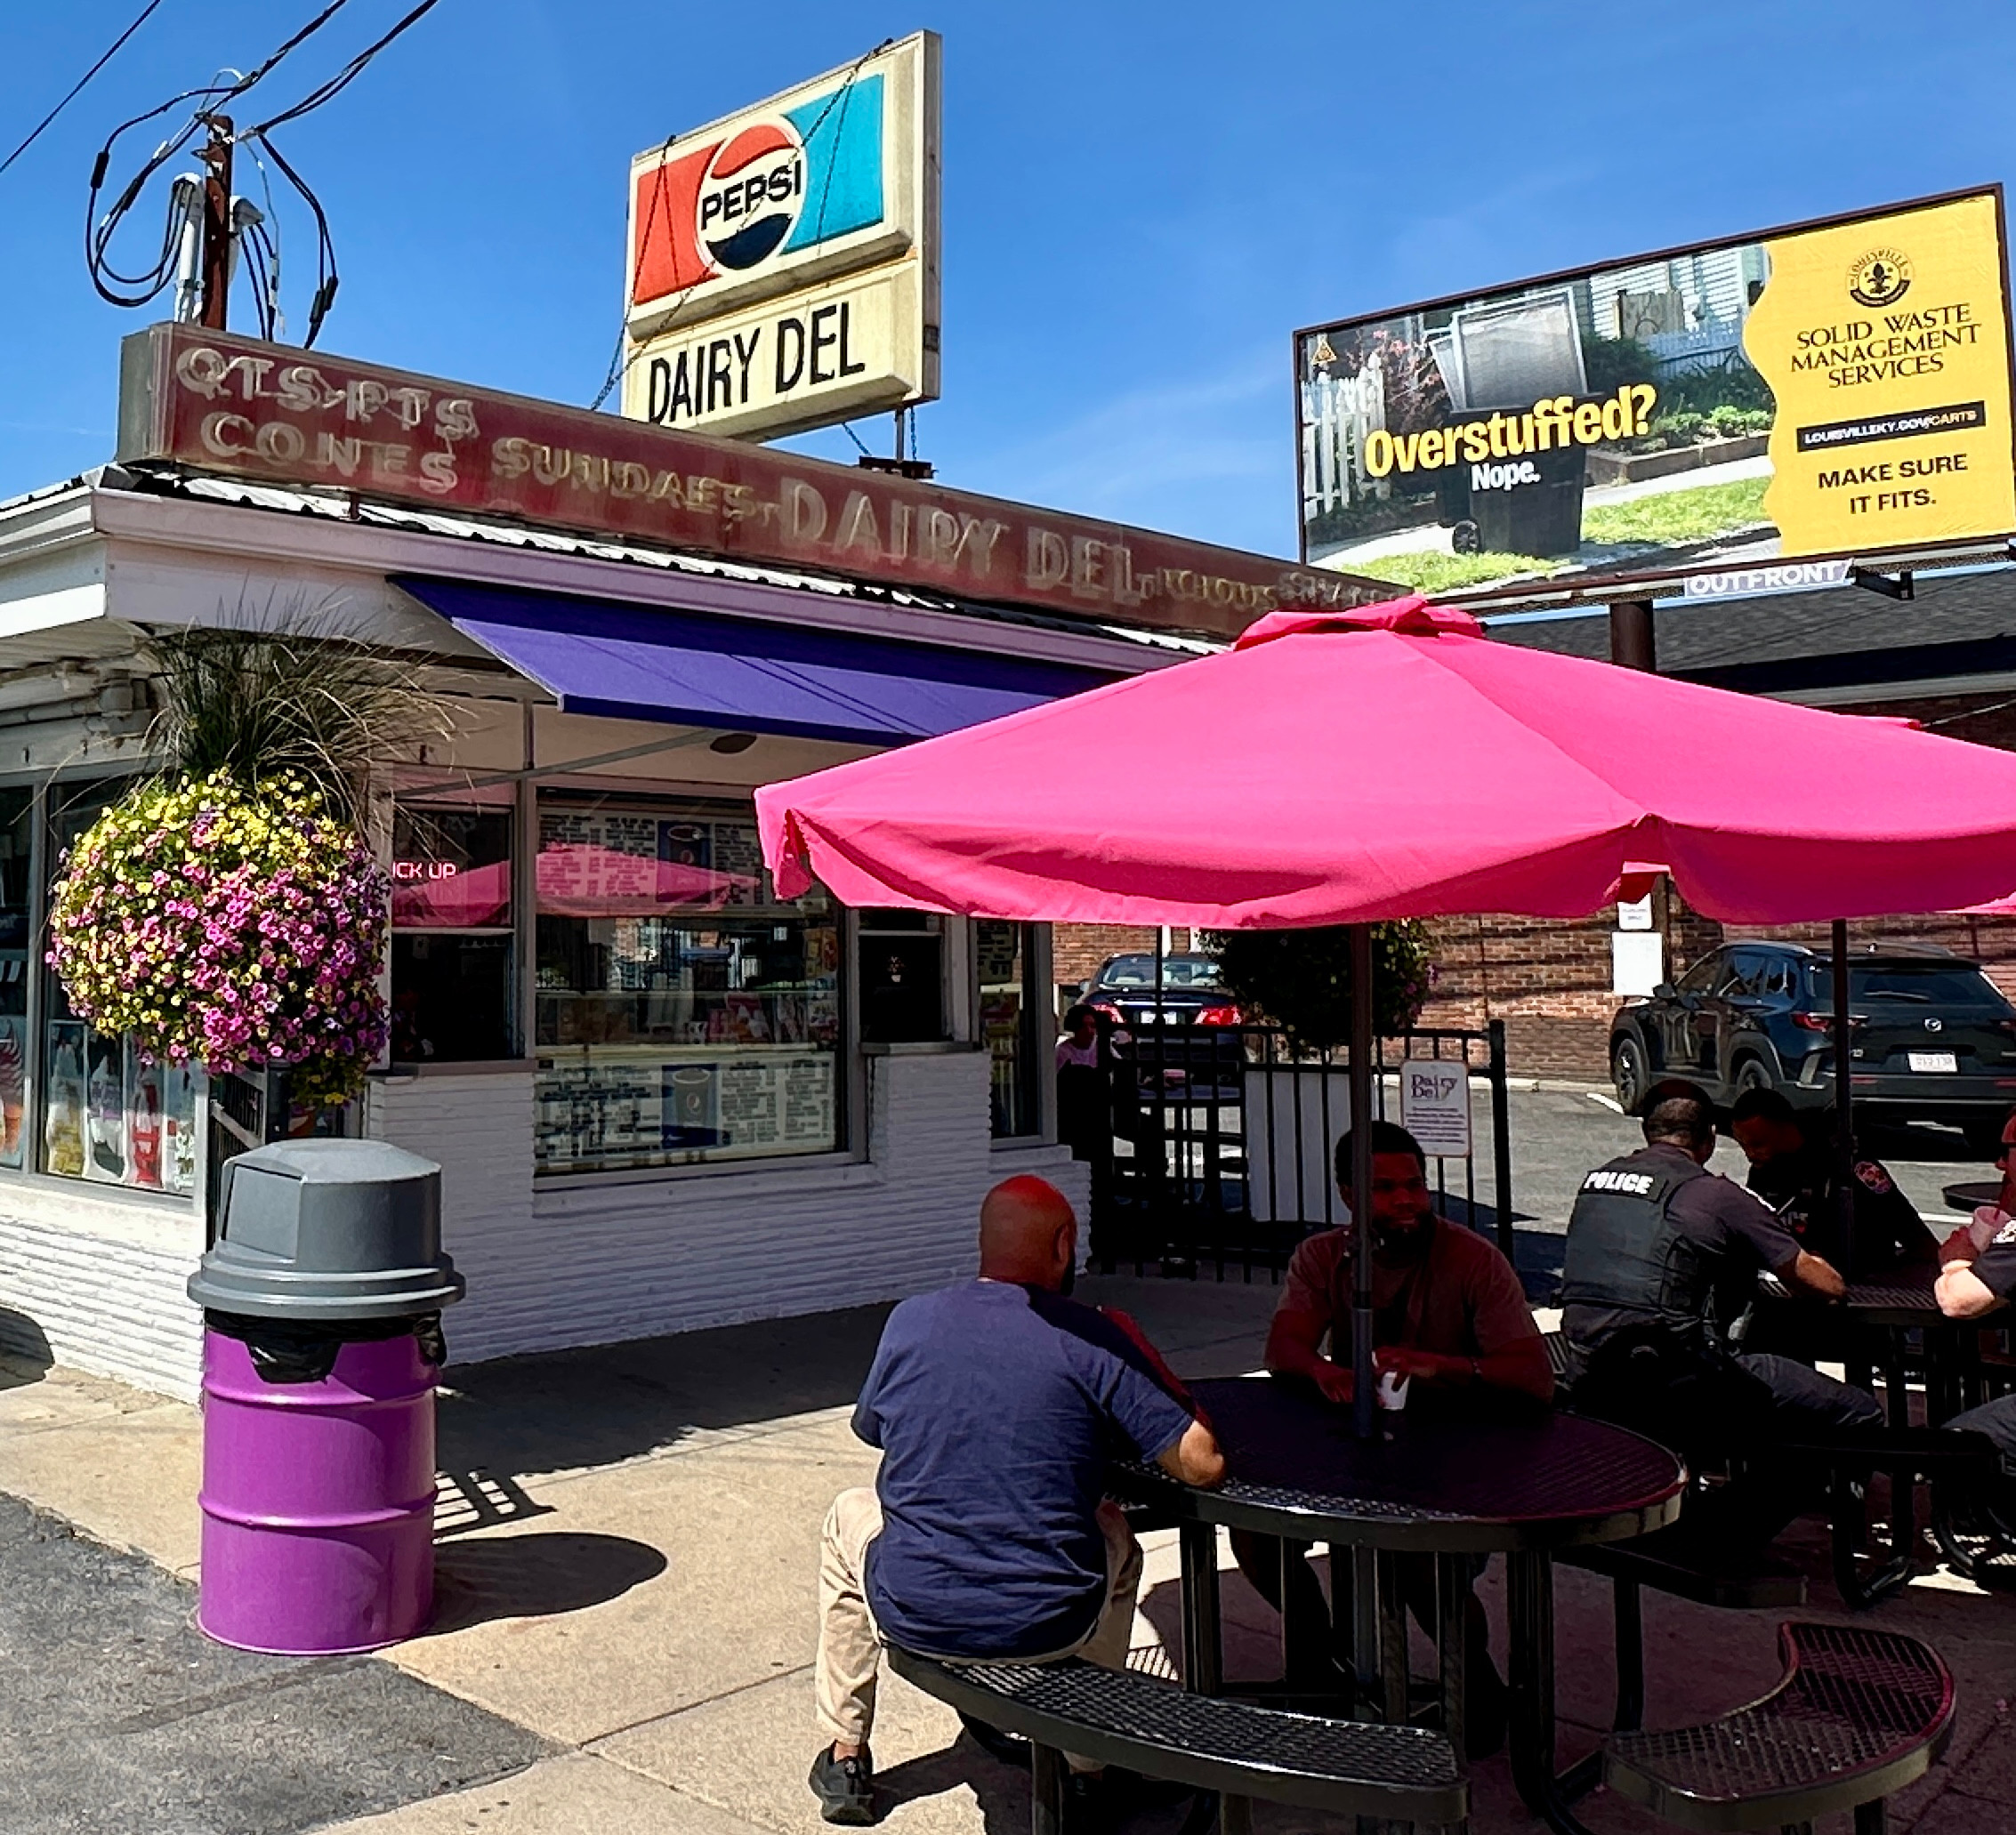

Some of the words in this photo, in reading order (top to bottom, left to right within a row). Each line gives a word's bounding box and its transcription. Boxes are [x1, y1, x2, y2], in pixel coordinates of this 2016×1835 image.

[701, 160, 801, 231] PEPSI
[1791, 323, 1982, 372] MANAGEMENT
[1796, 321, 1873, 350] SOLID
[1884, 302, 1972, 334] WASTE
[649, 327, 761, 423] DAIRY
[776, 302, 865, 395] DEL
[1828, 352, 1944, 388] SERVICES
[200, 411, 458, 494] CONES
[1365, 383, 1657, 478] Overstuffed?
[491, 437, 758, 521] SUNDAES
[1472, 461, 1542, 492] Nope.
[1818, 465, 1893, 488] MAKE
[1899, 453, 1968, 478] SURE
[1850, 495, 1870, 514] IT
[1878, 488, 1936, 511] FITS.
[779, 477, 1011, 578] DAIRY
[1689, 559, 1847, 594] OUTFRONT
[392, 862, 423, 879] ICK
[428, 862, 456, 880] UP
[1584, 1171, 1654, 1195] POLICE
